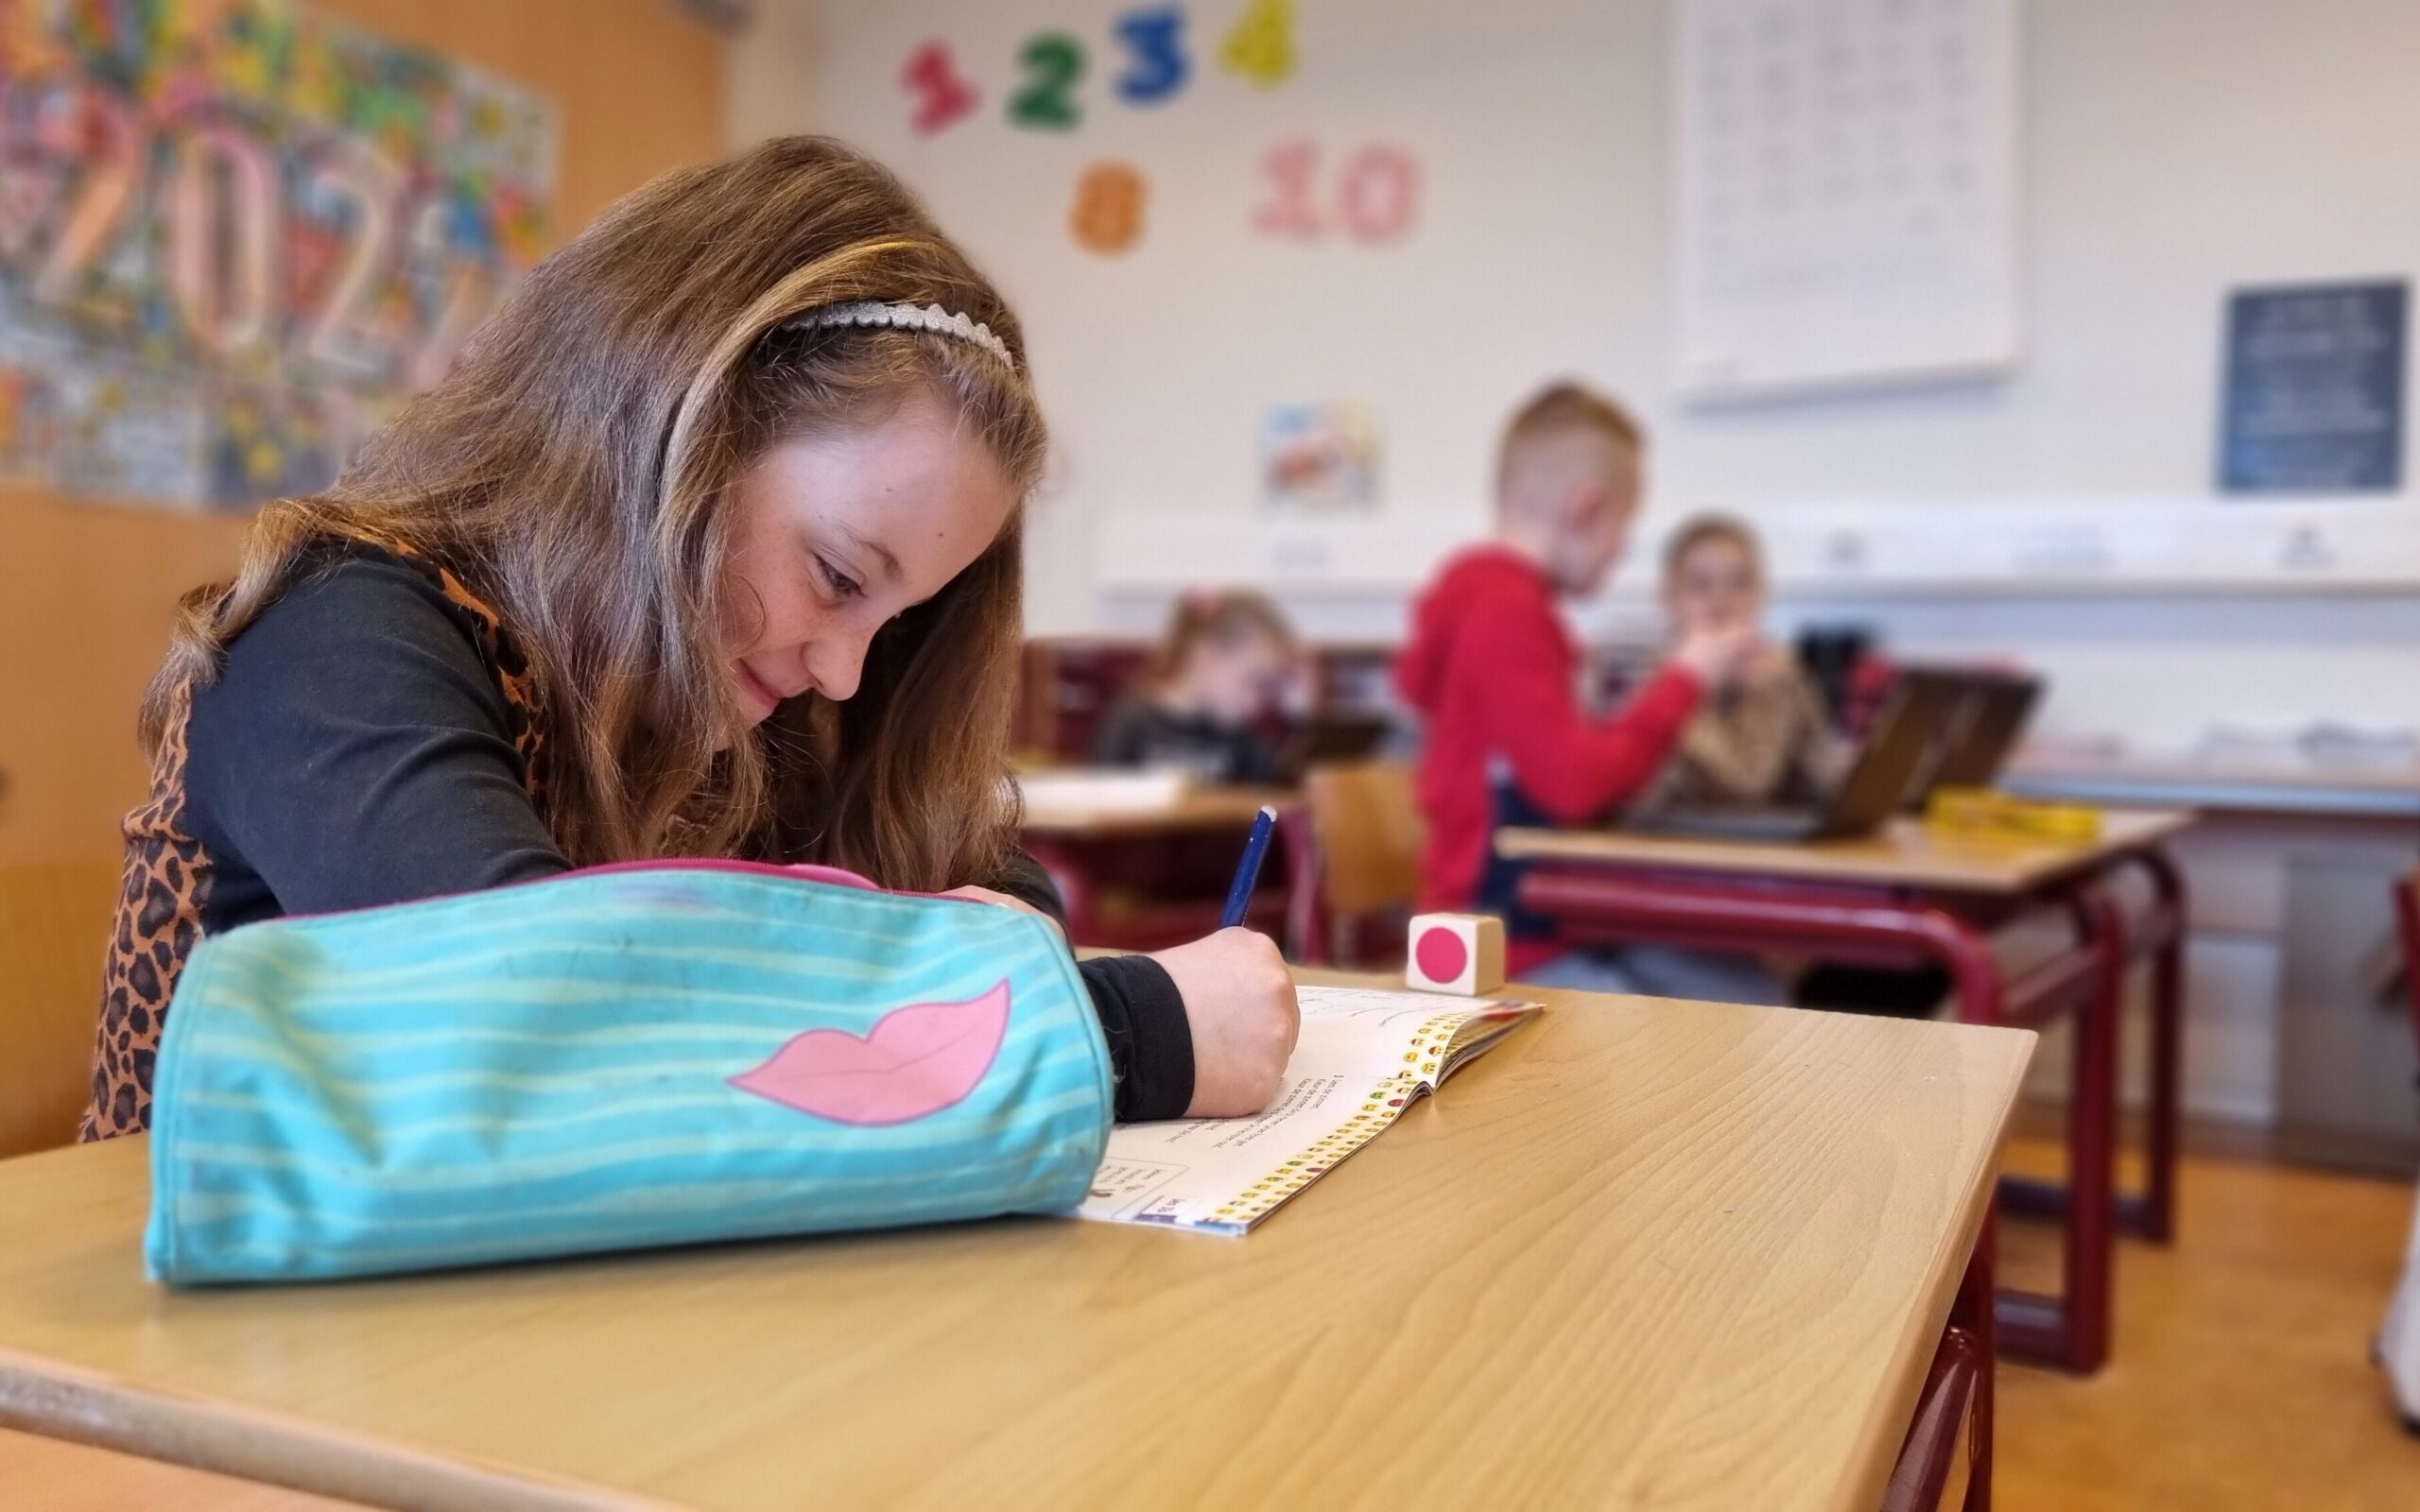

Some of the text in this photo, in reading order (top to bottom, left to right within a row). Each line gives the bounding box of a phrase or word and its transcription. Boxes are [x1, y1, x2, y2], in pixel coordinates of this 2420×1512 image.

[901, 0, 1297, 138] 1 2 3 4
[1250, 133, 1424, 247] 10
